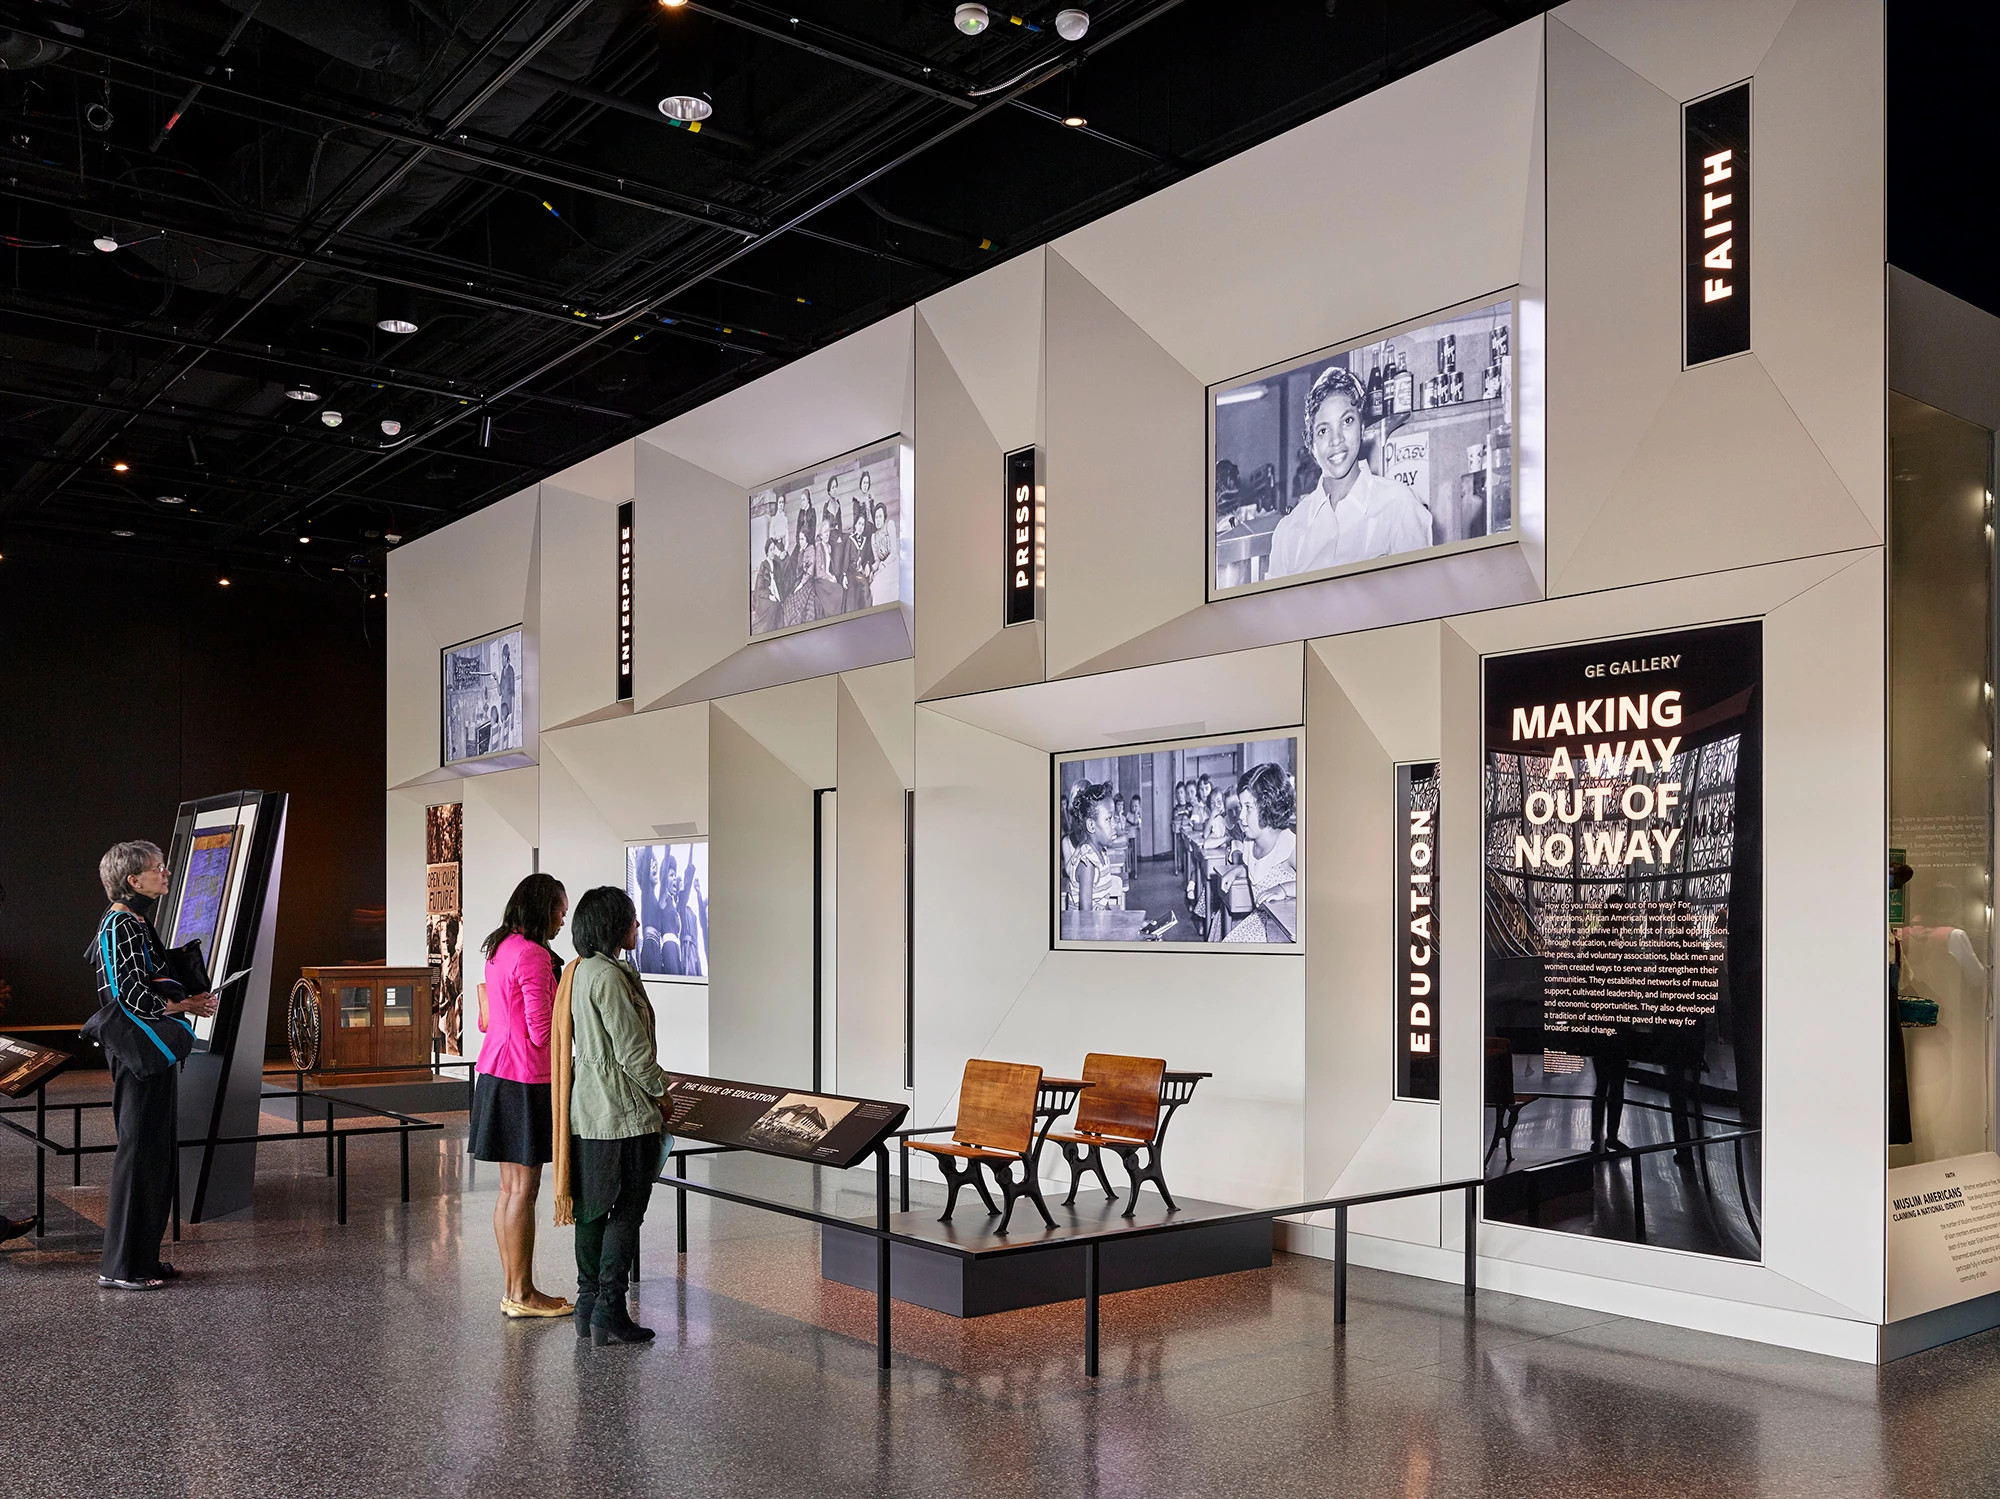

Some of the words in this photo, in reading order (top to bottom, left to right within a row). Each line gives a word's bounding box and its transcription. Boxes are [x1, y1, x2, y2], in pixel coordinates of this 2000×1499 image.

[1704, 149, 1732, 303] FAITH
[1016, 484, 1029, 588] PRESS
[622, 526, 630, 675] ENTERPRISE
[1585, 663, 1605, 678] GE
[1610, 654, 1681, 675] GALLERY
[1512, 690, 1682, 741] MAKING
[1548, 746, 1576, 780] A
[1584, 736, 1682, 778] WAY
[1525, 787, 1612, 825] OUT
[1622, 782, 1681, 820] OF
[1515, 833, 1574, 868] NO
[1583, 828, 1682, 866] WAY
[429, 890, 454, 911] FUTURE
[1609, 903, 1623, 911] way
[1638, 901, 1647, 909] of
[1659, 901, 1677, 911] way?
[1410, 809, 1431, 1053] EDUCATION
[1577, 926, 1590, 934] and
[1591, 926, 1611, 934] thrive
[1612, 926, 1619, 934] in
[1620, 926, 1632, 934] the
[1655, 926, 1664, 934] of
[1545, 939, 1571, 948] Through
[1572, 940, 1607, 948] education,
[1608, 940, 1637, 949] religious
[1639, 940, 1682, 948] institutions,
[1683, 940, 1725, 949] businesses,
[1556, 952, 1576, 960] press,
[1590, 951, 1623, 961] voluntary
[1624, 952, 1669, 961] associations,
[1670, 952, 1690, 960] black
[1709, 953, 1724, 961] and
[1643, 965, 1657, 973] and
[1658, 966, 1699, 976] strengthen
[1700, 966, 1719, 974] their
[1544, 976, 1588, 984] communities.
[1589, 976, 1606, 986] They
[1607, 976, 1646, 985] established
[1647, 978, 1681, 986] networks
[1682, 978, 1691, 986] of
[1692, 979, 1719, 987] mutual
[1544, 988, 1572, 996] support,
[1573, 988, 1605, 996] cultivated
[1606, 989, 1644, 1000] leadership,
[1660, 991, 1695, 1000] improved
[1697, 992, 1719, 1000] social
[1558, 1000, 1590, 1008] economic
[1591, 1002, 1639, 1010] opportunities.
[1640, 1003, 1659, 1013] They
[1660, 1004, 1675, 1012] also
[1676, 1004, 1715, 1014] developed
[1544, 1023, 1569, 1031] broader
[1571, 1025, 1590, 1033] social
[1591, 1026, 1618, 1036] change.
[1550, 1012, 1578, 1020] tradition
[1587, 1014, 1615, 1022] activism
[1632, 1016, 1654, 1024] paved
[1655, 1016, 1667, 1024] the
[1669, 1018, 1683, 1027] way
[1684, 1017, 1696, 1026] for
[682, 1082, 699, 1091] THE
[697, 1084, 722, 1094] VALUE
[721, 1088, 735, 1096] OF
[731, 1090, 778, 1103] EDUCATION
[1893, 1196, 1922, 1210] MUSLIM
[1923, 1187, 1962, 1204] AMERICANS
[1892, 1210, 1916, 1222] CLAIMING
[1921, 1205, 1945, 1215] NATIONAL
[1944, 1200, 1966, 1210] IDENTITY
